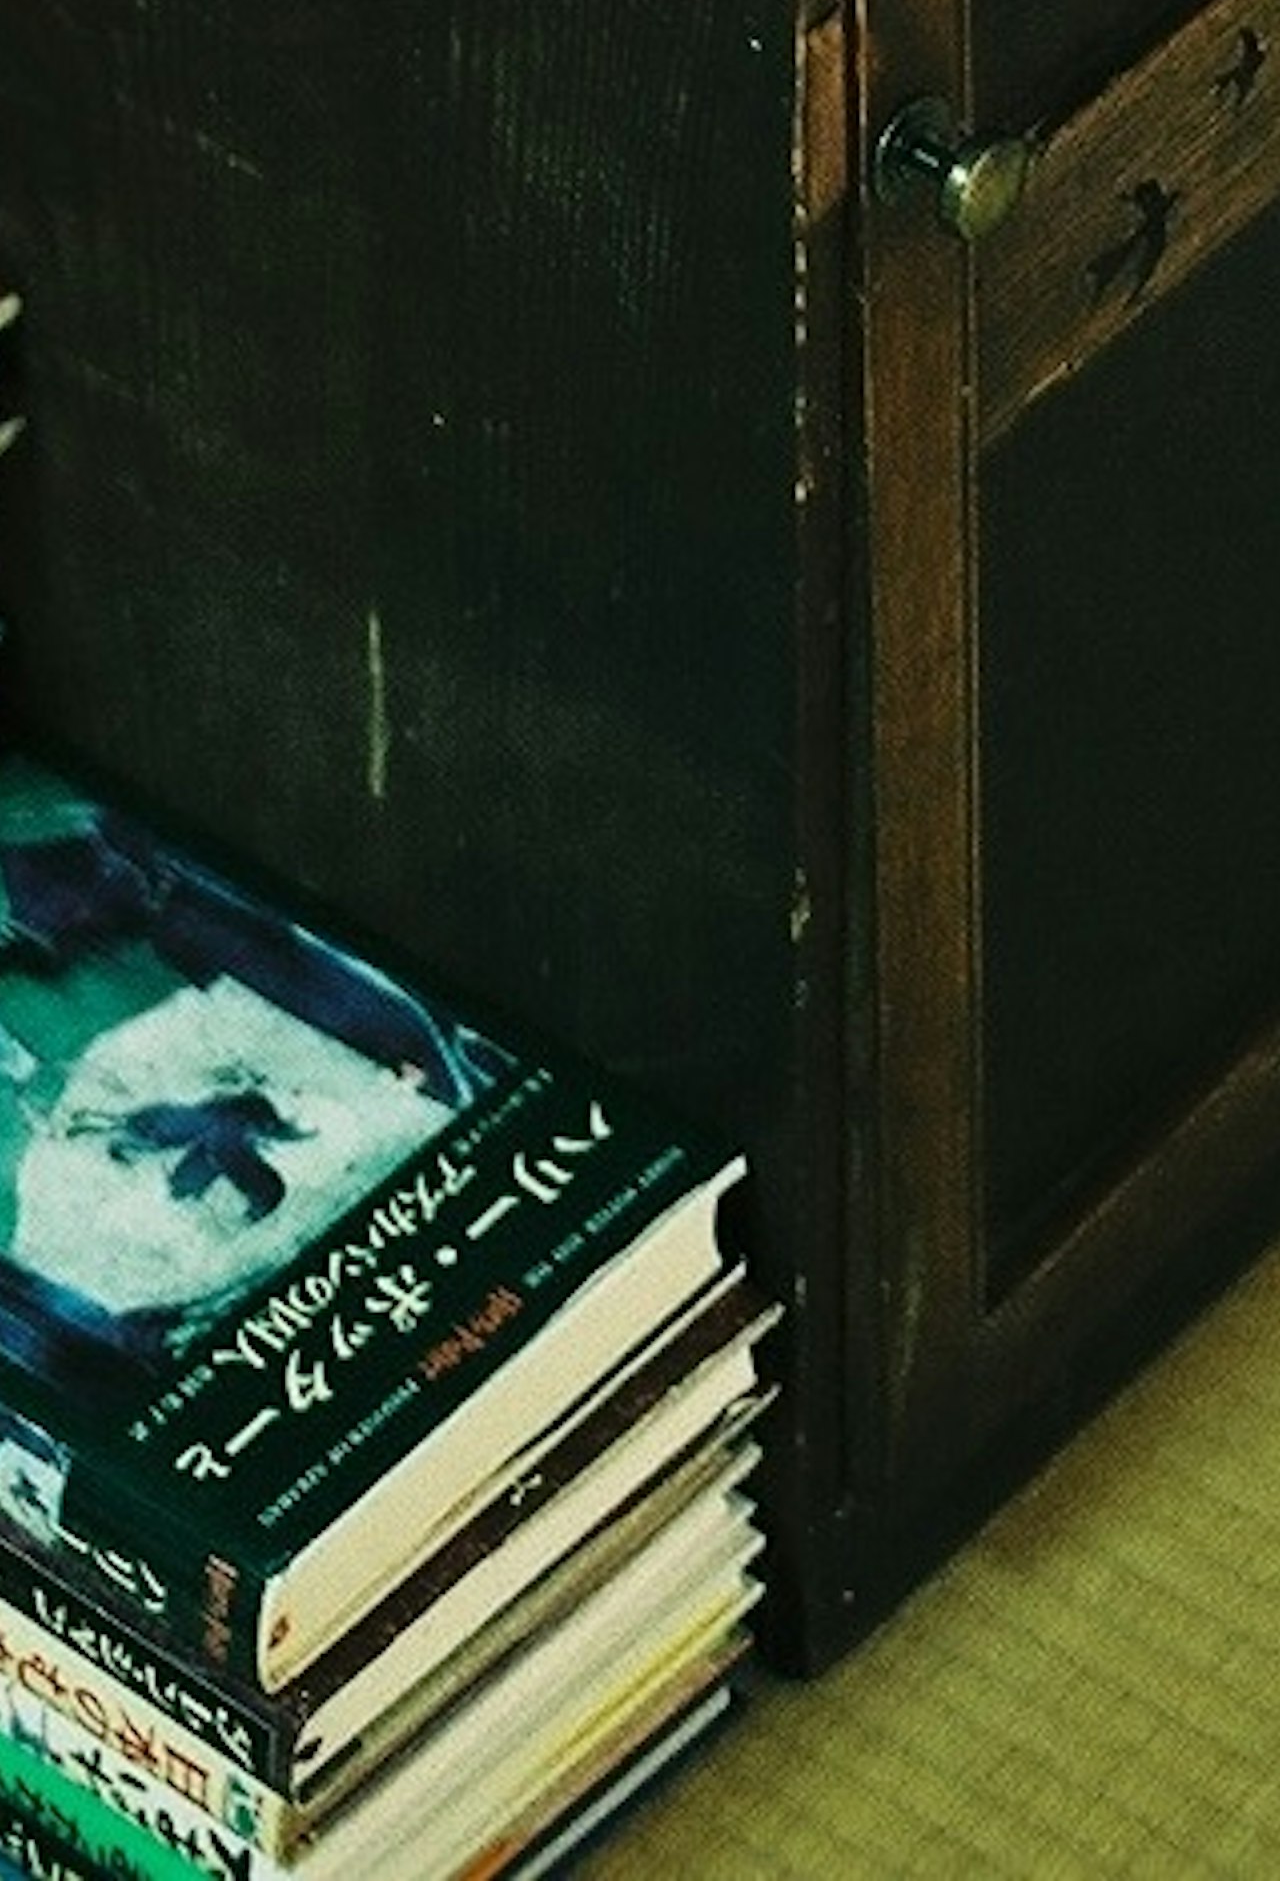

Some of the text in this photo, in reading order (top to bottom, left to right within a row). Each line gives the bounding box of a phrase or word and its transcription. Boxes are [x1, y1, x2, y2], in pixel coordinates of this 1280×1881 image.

[174, 1098, 612, 1481] ハリー・ポッターと
[213, 1153, 476, 1369] アズカバンの囚人
